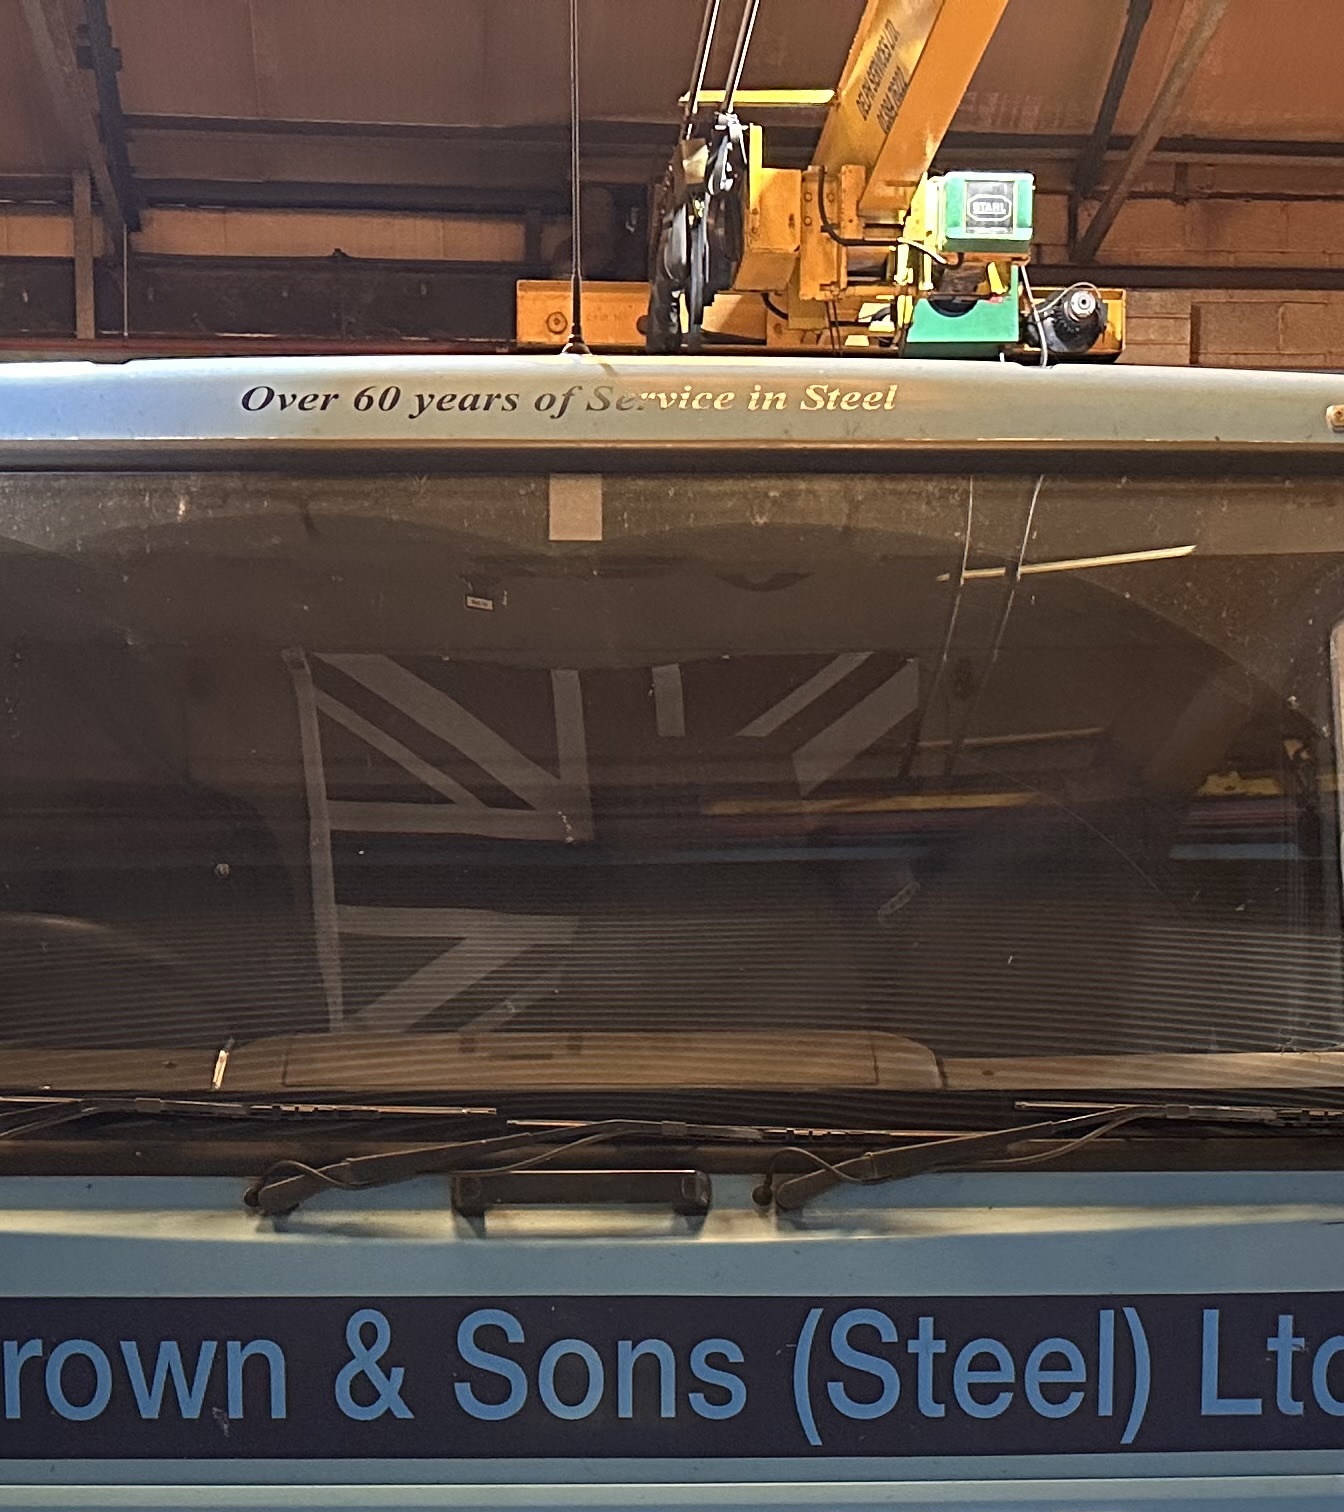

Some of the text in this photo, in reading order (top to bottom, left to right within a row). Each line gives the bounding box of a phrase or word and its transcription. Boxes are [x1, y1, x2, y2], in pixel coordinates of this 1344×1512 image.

[241, 383, 898, 419] Over 60 years of Service in Steel
[333, 1308, 415, 1421] &
[454, 1308, 747, 1421] Sons
[793, 1306, 1152, 1446] (Steel)
